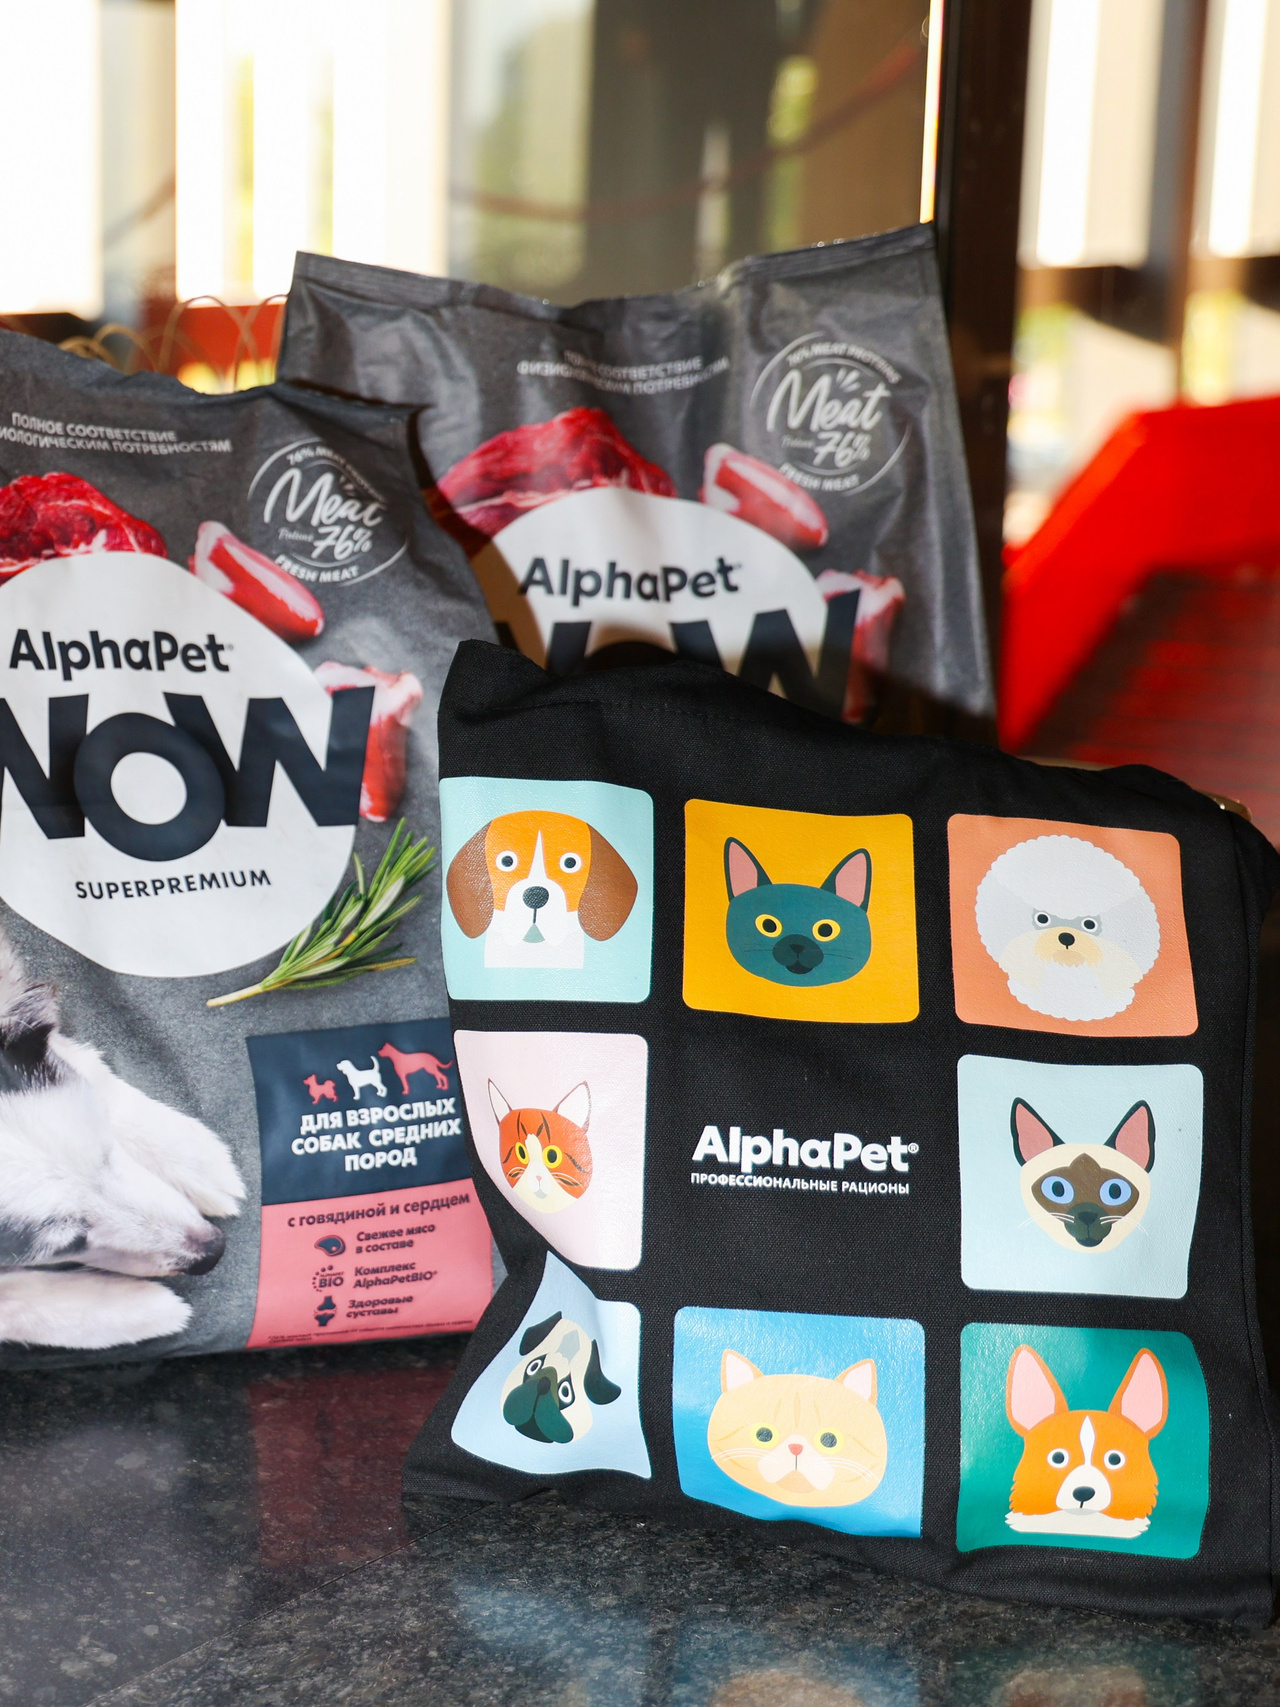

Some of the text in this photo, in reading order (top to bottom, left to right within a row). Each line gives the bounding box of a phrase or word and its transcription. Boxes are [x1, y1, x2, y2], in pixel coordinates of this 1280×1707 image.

[766, 369, 892, 432] Meat
[12, 412, 177, 442] ПОЛНОЕ СООТВЕТСТВИЕ
[112, 439, 232, 455] ПОТРЕБНОСТЯМ
[813, 431, 871, 467] 76%
[263, 468, 386, 527] Meat
[311, 524, 373, 560] 76%
[274, 554, 360, 583] FRESH MEAT
[519, 556, 740, 606] AlphaPet
[74, 869, 271, 900] SUPERPREMIUM
[300, 1097, 456, 1135] ДЛЯ ВЗРОСЛЫХ
[291, 1118, 462, 1155] СОБАК СРЕДНИХ
[344, 1147, 417, 1171] ПОРОД
[691, 1172, 910, 1195] ПРОФЕССИОНАЛЬНЫЕ РАЦИОНЫ
[287, 1192, 470, 1228] с говядиной и сердцем
[355, 1239, 414, 1254] в составе
[356, 1224, 436, 1242] Свежее мясо
[318, 1276, 344, 1288] BIO
[354, 1262, 416, 1276] Комплекс
[346, 1307, 399, 1319] суставы
[348, 1295, 414, 1309] Здоровые
